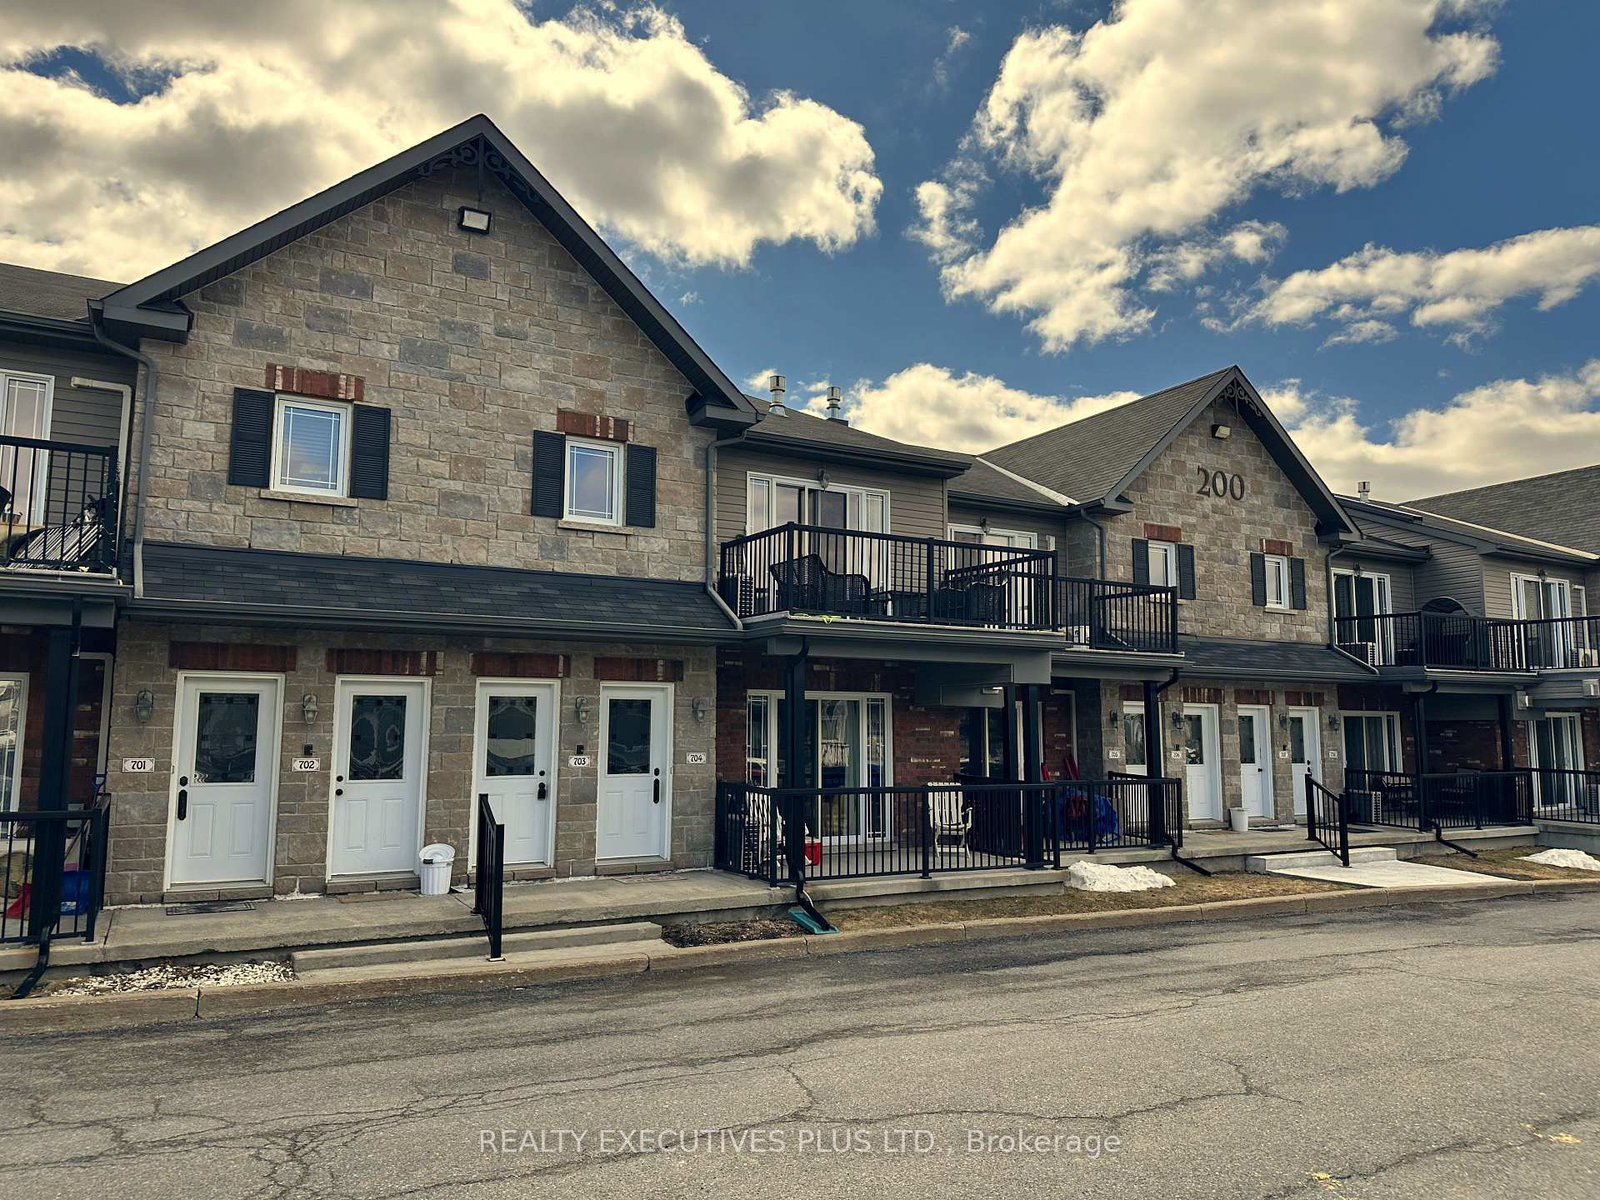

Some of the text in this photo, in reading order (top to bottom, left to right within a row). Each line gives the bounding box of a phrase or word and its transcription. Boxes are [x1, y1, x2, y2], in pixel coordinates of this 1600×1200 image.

[1197, 465, 1245, 501] 200
[573, 757, 587, 766] 703
[690, 754, 703, 763] 704
[131, 760, 147, 770] 701
[298, 760, 315, 770] 702
